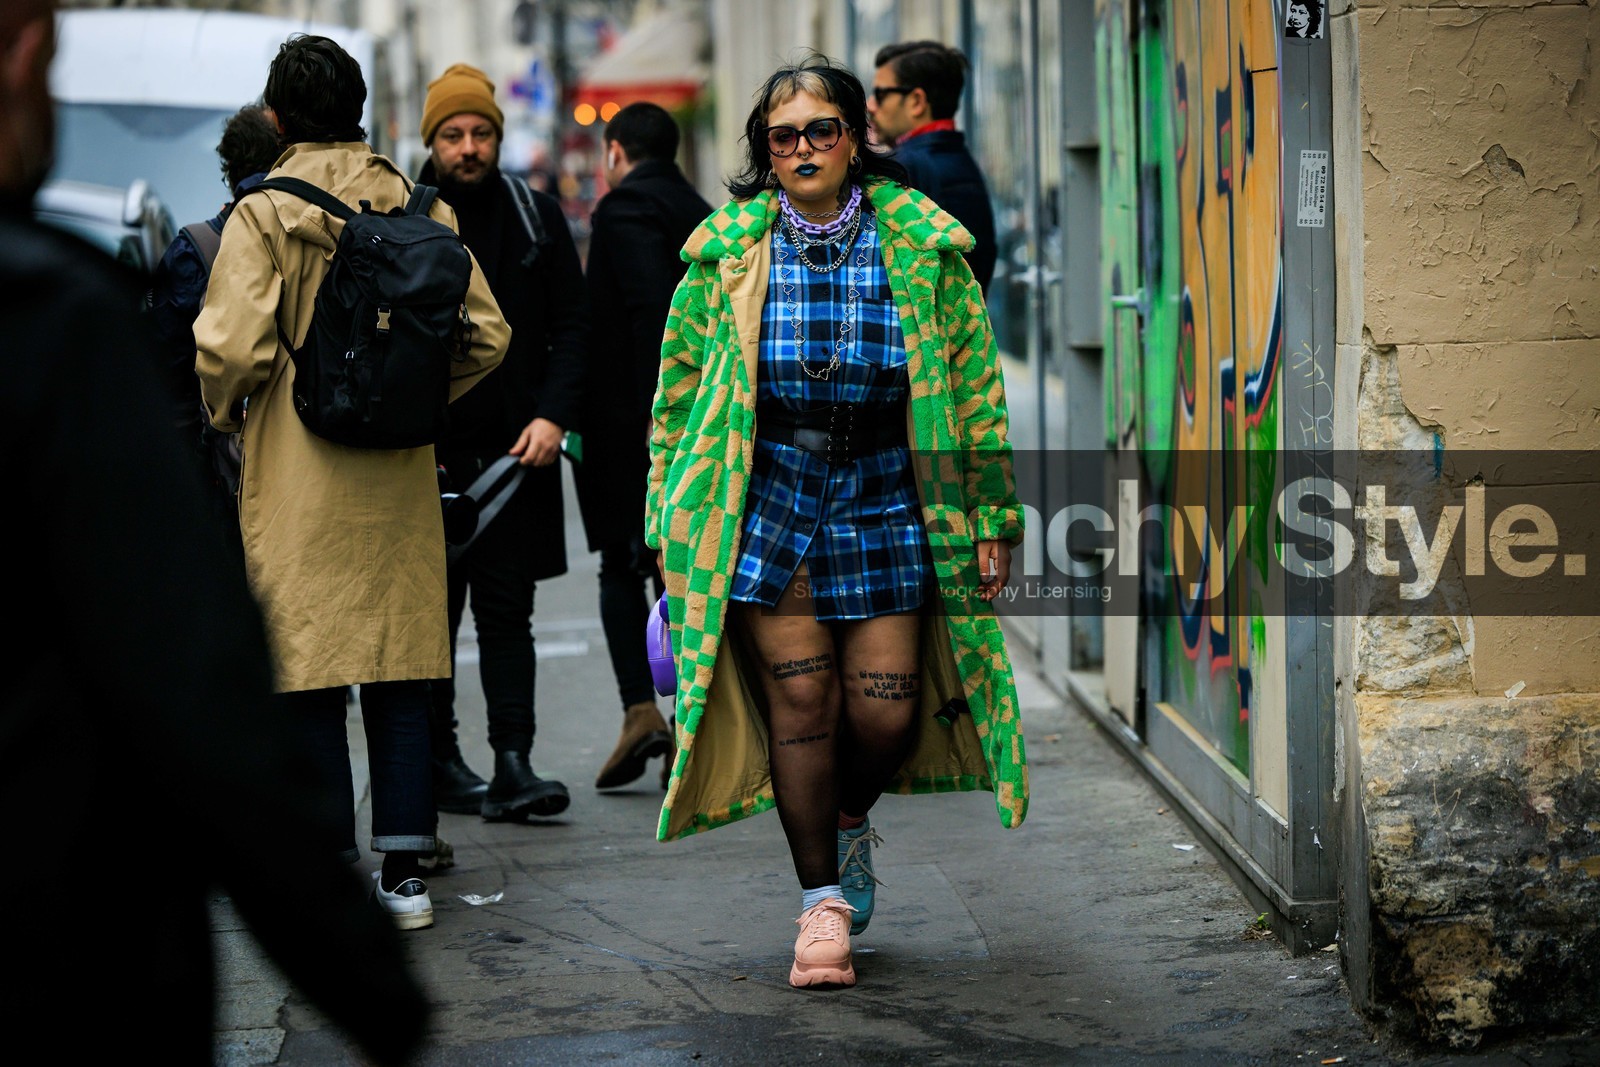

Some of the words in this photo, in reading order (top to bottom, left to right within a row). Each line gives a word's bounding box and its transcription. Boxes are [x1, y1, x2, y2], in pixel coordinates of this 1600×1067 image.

[1321, 165, 1326, 174] 09
[1320, 176, 1326, 184] 72
[1320, 186, 1325, 194] 10
[1319, 195, 1325, 203] 54
[1319, 205, 1324, 213] 40
[885, 672, 899, 681] PAS
[407, 882, 421, 892] TF
